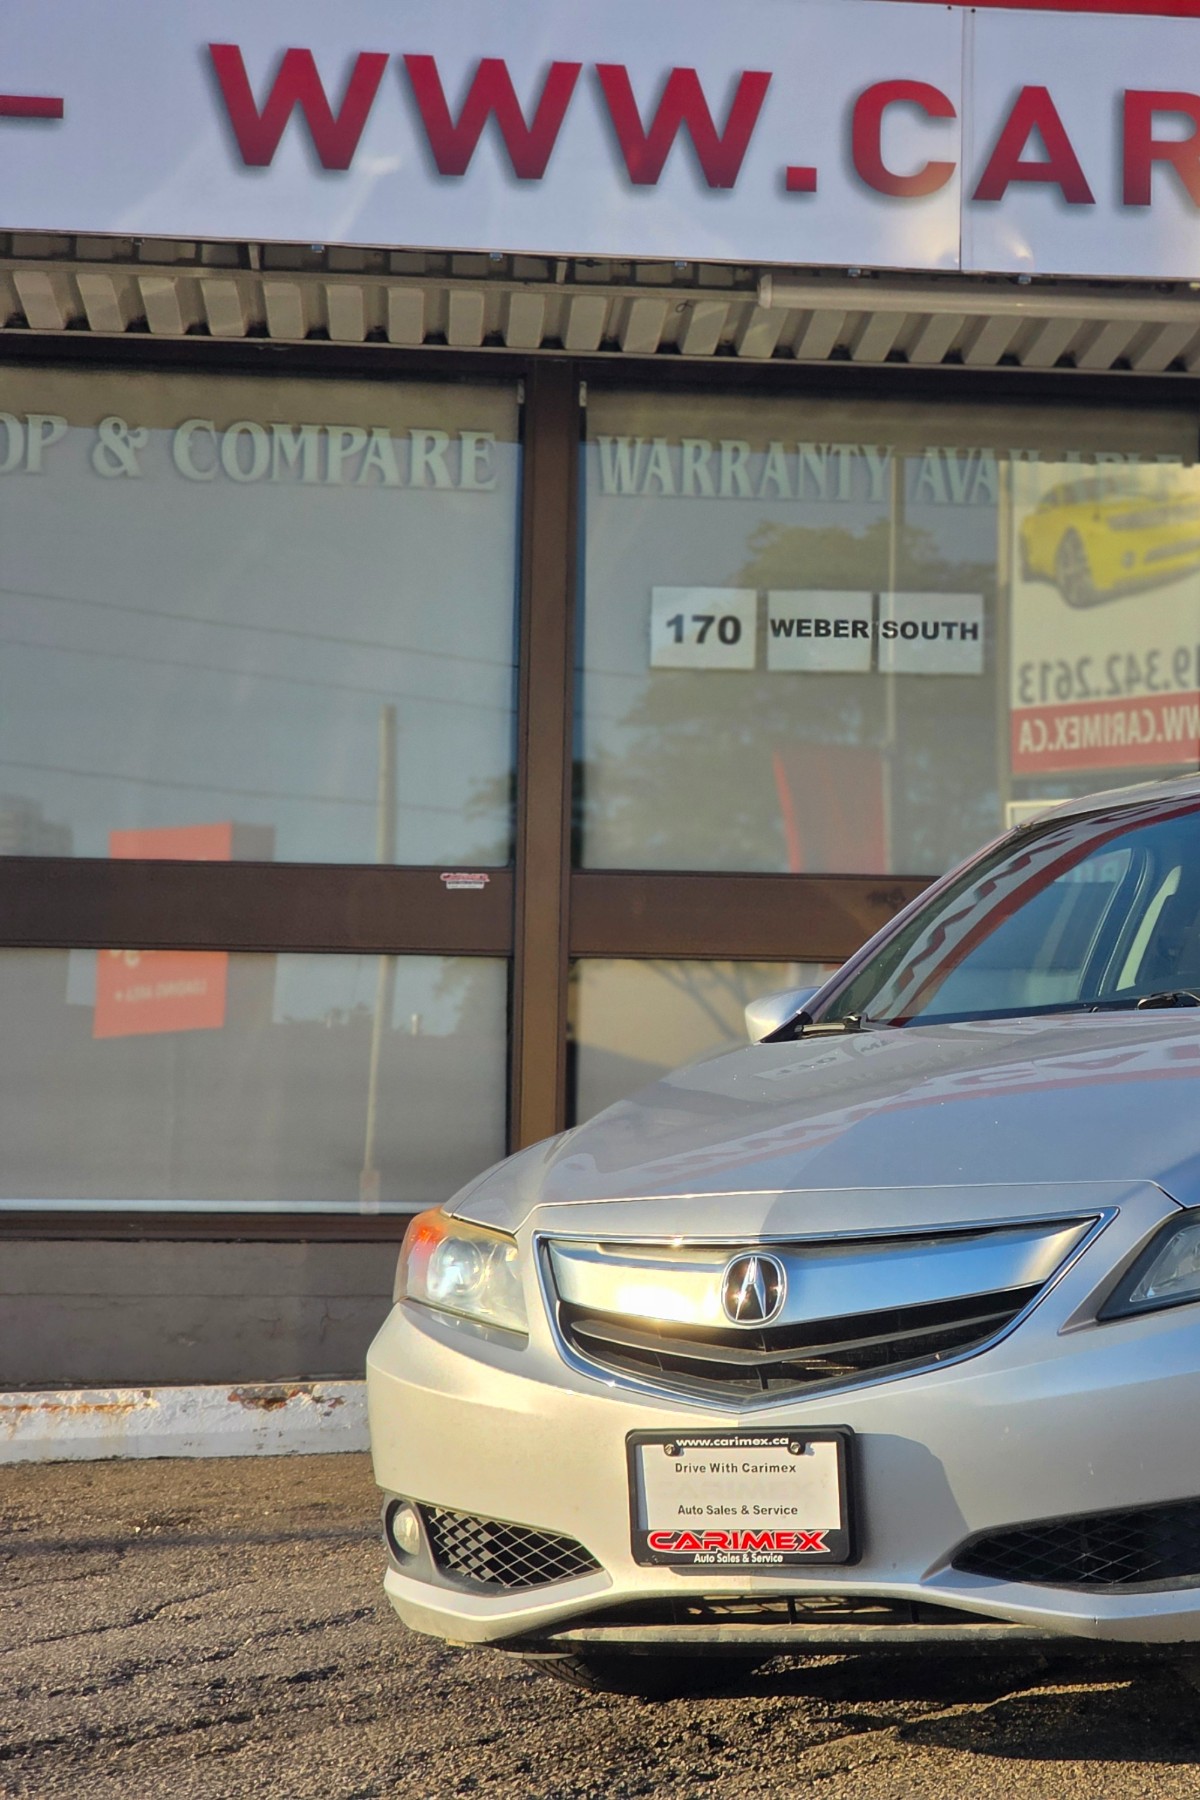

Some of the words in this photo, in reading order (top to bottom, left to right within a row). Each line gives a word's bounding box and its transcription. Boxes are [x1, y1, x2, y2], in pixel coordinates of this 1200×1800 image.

[92, 416, 149, 479] &
[173, 418, 499, 491] COMPARE
[598, 435, 895, 502] WARRANTY
[665, 614, 742, 645] 170
[770, 618, 870, 639] WEBER
[881, 620, 980, 642] SOUTH
[676, 1436, 789, 1447] www.carimex.ca
[675, 1462, 706, 1474] Drive
[710, 1462, 738, 1474] With
[742, 1462, 796, 1474] Carimex
[678, 1505, 703, 1516] Auto
[706, 1504, 737, 1516] Sales
[741, 1505, 749, 1516] &
[753, 1504, 798, 1516] Service
[648, 1529, 831, 1552] CARIMEX
[694, 1552, 715, 1563] Auto
[717, 1552, 740, 1563] Sales
[742, 1552, 749, 1563] &
[751, 1552, 783, 1563] Service
